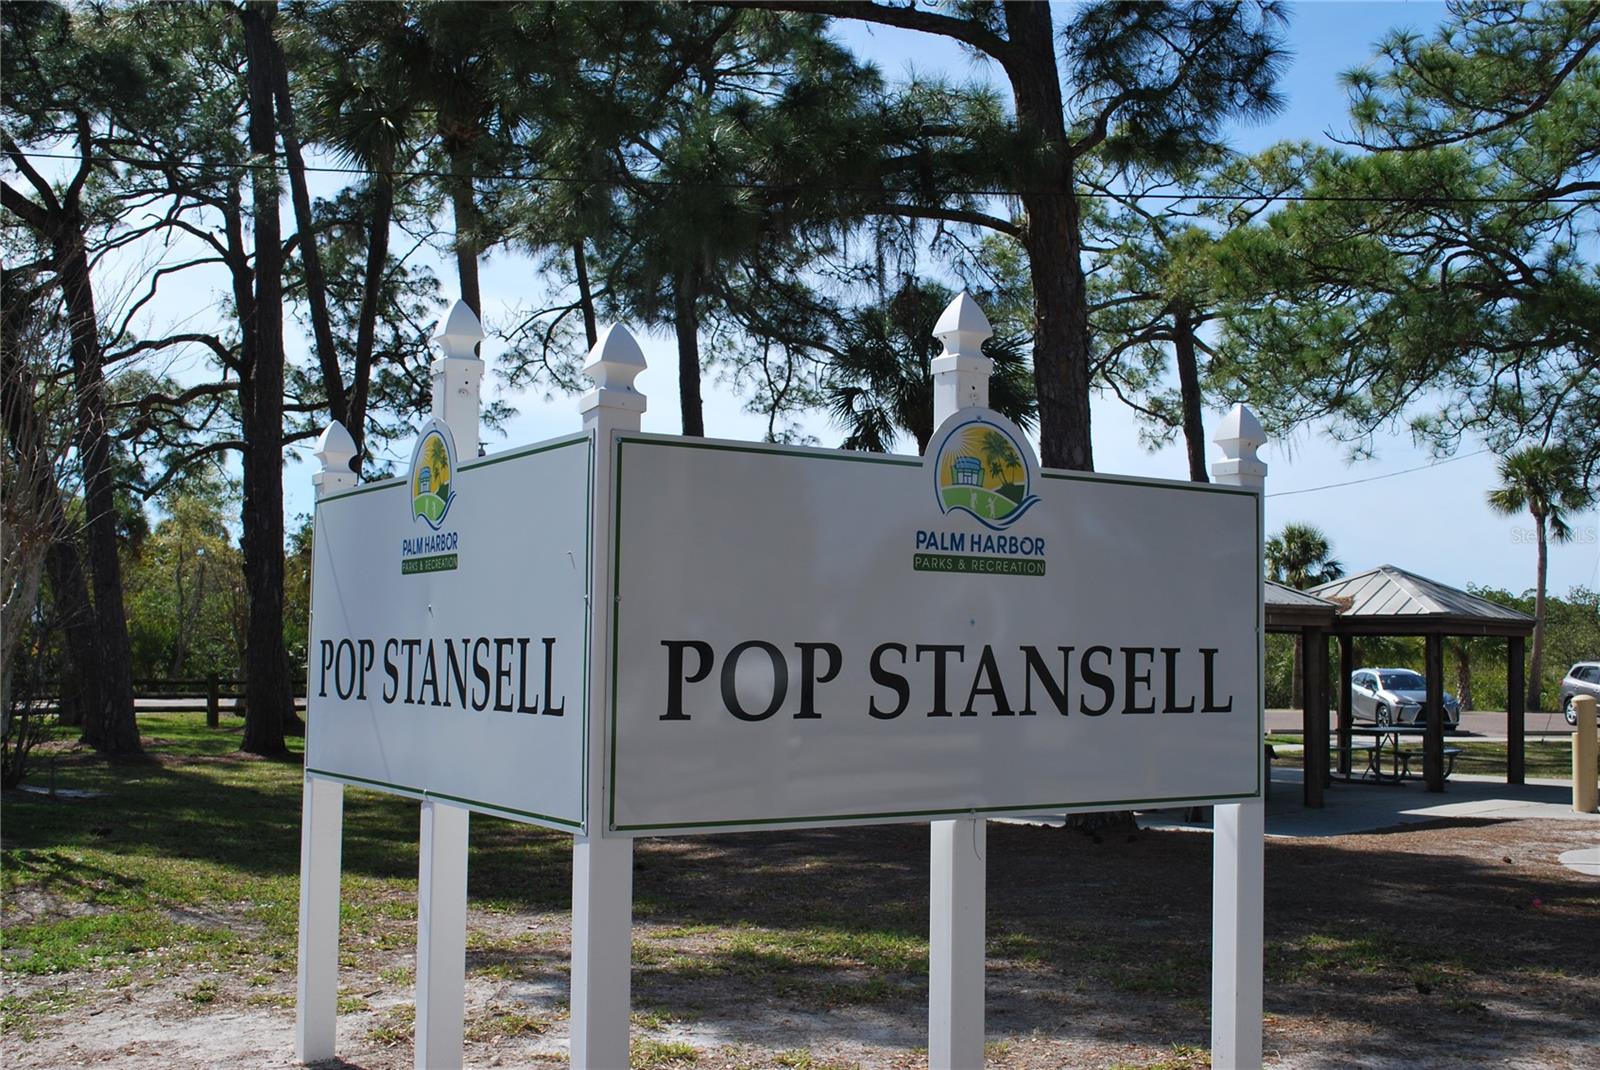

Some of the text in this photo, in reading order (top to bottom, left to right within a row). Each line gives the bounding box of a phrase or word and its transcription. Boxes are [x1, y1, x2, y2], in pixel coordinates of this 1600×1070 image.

[402, 532, 458, 556] PALM HARBOR
[916, 530, 1045, 556] PALM HARBOR
[914, 557, 1045, 574] PARKS & RECREATION
[319, 637, 565, 716] POP STANSELL
[659, 639, 1233, 722] POP STANSELL
